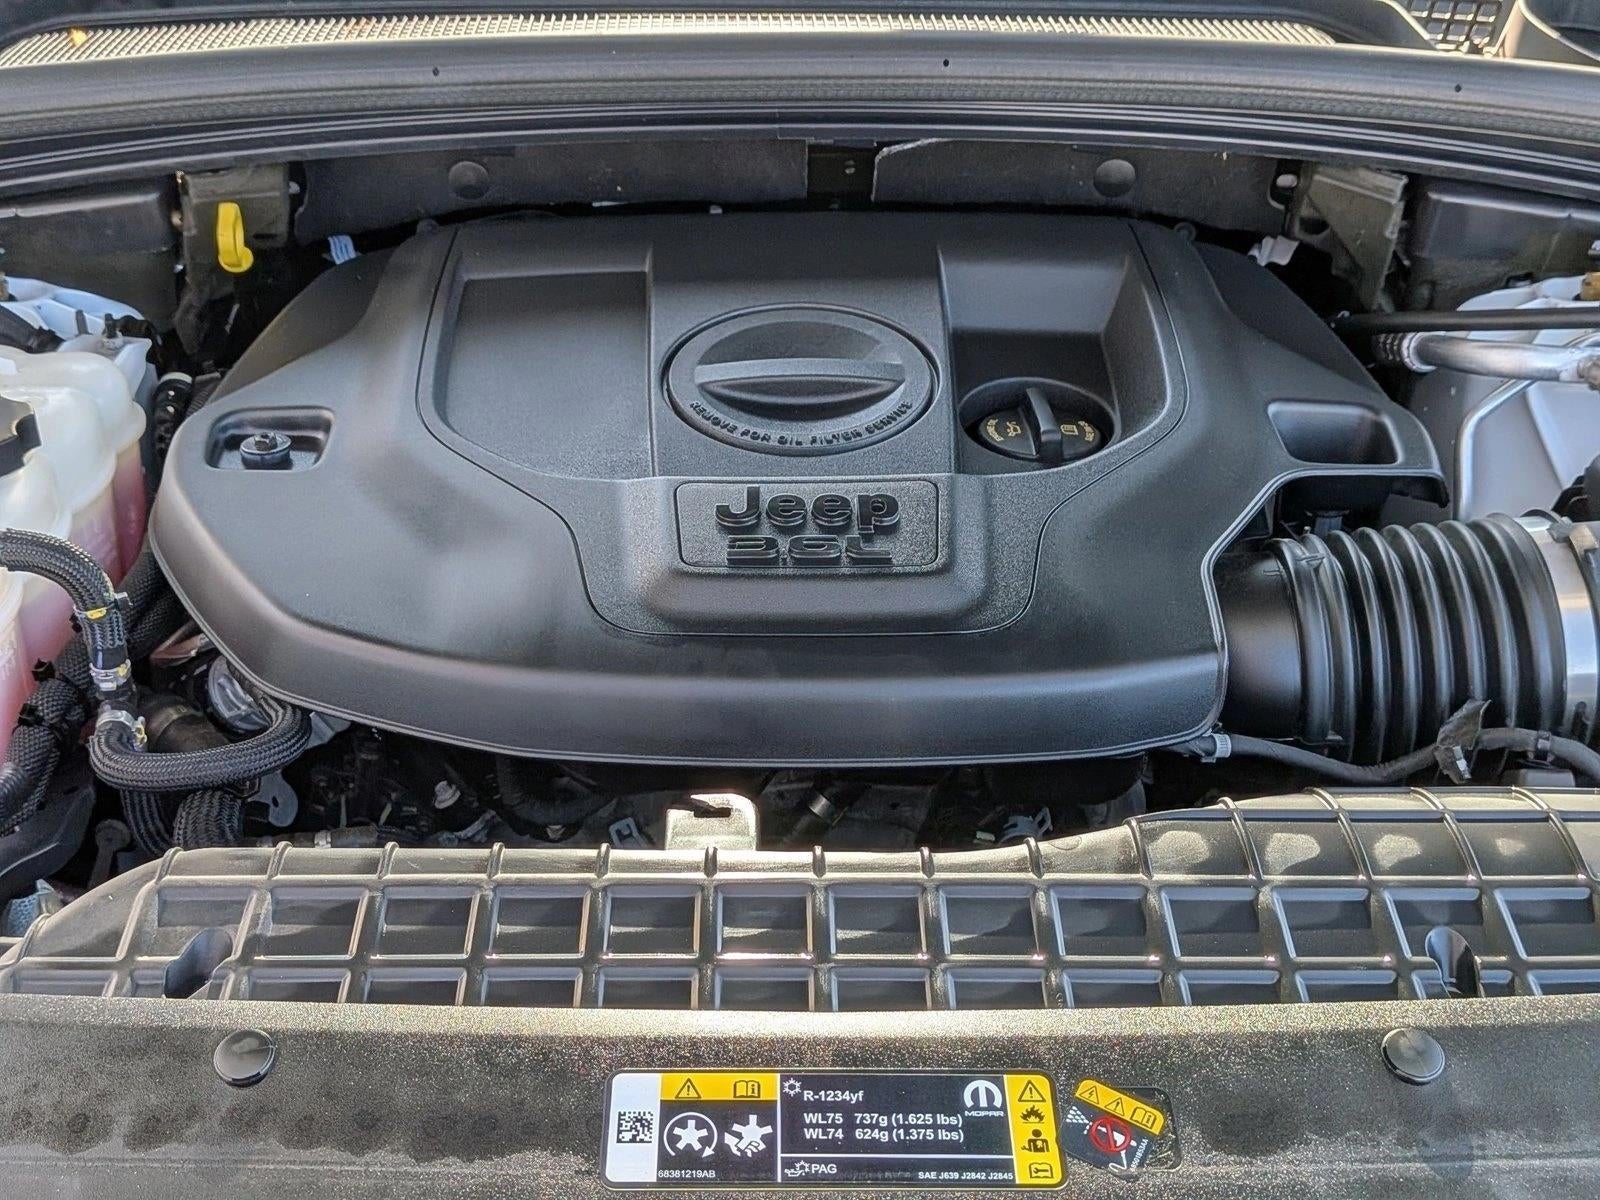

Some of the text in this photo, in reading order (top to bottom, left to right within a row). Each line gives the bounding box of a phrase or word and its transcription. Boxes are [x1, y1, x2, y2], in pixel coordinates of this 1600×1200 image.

[690, 401, 914, 446] REMOVE FOR OIL FILTER SERVICE
[715, 484, 900, 533] Jeep
[803, 1090, 864, 1104] R-1234yf
[803, 1112, 963, 1128] WL75 737g (1.625 lbs)
[964, 1110, 1005, 1118] MOPAR
[803, 1128, 964, 1143] WL74 624g (1.375 lbs)
[657, 1169, 716, 1178] 68381219AB
[811, 1163, 837, 1174] PAG
[918, 1171, 937, 1180] SAE
[938, 1171, 959, 1180] J639
[961, 1171, 986, 1180] J2842
[988, 1171, 1013, 1180] J2845
